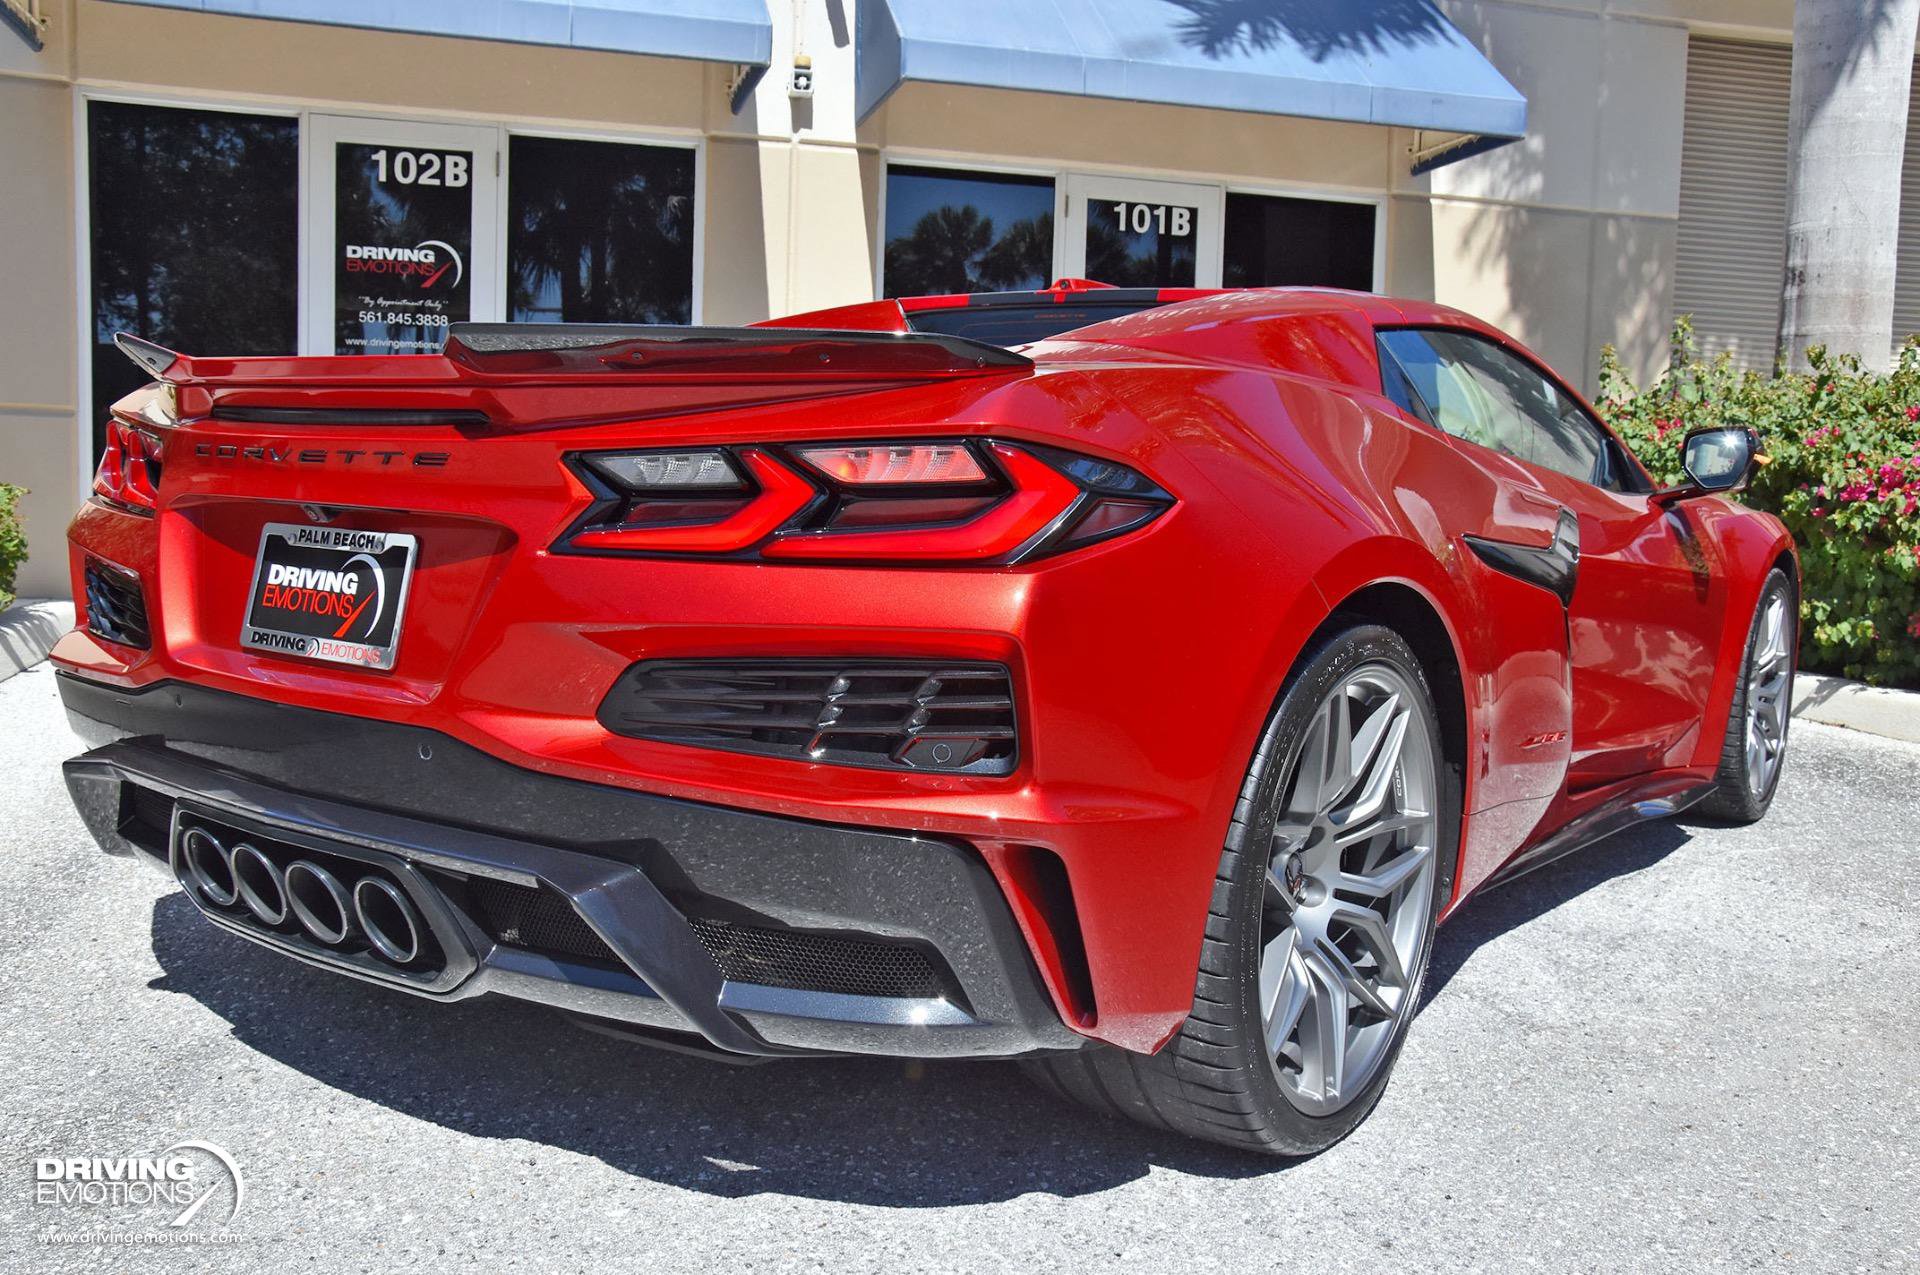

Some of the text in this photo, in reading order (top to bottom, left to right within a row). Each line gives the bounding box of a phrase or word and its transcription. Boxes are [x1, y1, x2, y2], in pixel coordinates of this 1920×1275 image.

[371, 150, 468, 188] 102B
[1113, 202, 1191, 237] 101B
[346, 245, 435, 263] DRIVING
[346, 259, 436, 276] EMOTIONS
[358, 311, 449, 327] 561.845.3838
[194, 443, 451, 467] CORVETTE
[298, 529, 376, 550] PALM BEACH
[266, 564, 359, 596] DRIVING
[261, 585, 355, 619] EMOTIONS
[250, 631, 307, 652] DRIVING
[320, 642, 382, 664] EMOTIONS
